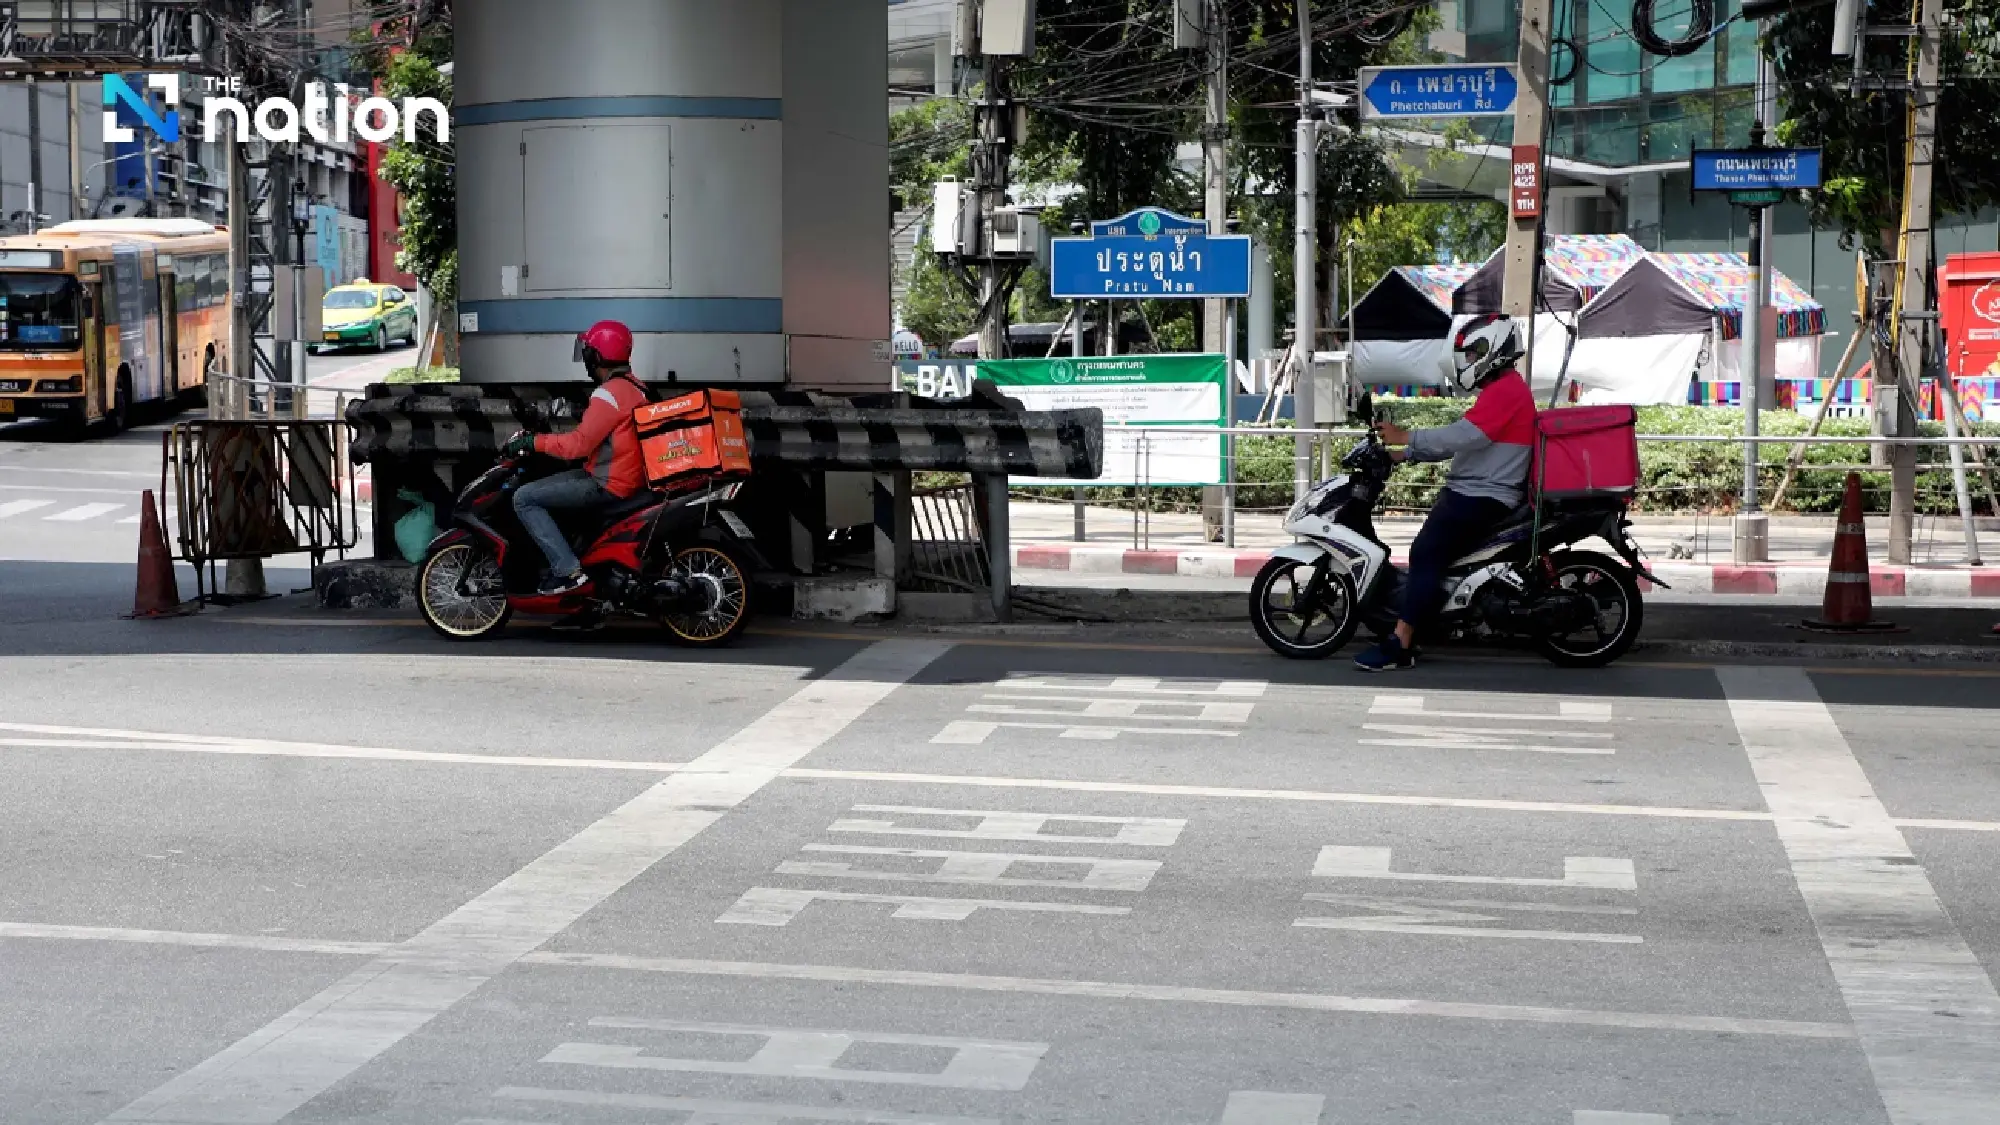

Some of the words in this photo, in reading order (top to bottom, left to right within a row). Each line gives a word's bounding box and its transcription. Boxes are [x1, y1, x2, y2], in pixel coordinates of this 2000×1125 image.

[1417, 68, 1496, 98] เพชรบุรี
[1390, 100, 1463, 112] Phetchaburi
[1474, 98, 1496, 110] Rd.
[1513, 162, 1536, 175] RPR
[1716, 152, 1797, 175] ถนนเพชรบุรี
[1513, 175, 1536, 187] 422
[1096, 235, 1201, 281] ประตูน้ำ
[1104, 279, 1149, 292] Pratu
[1162, 279, 1195, 292] Nam
